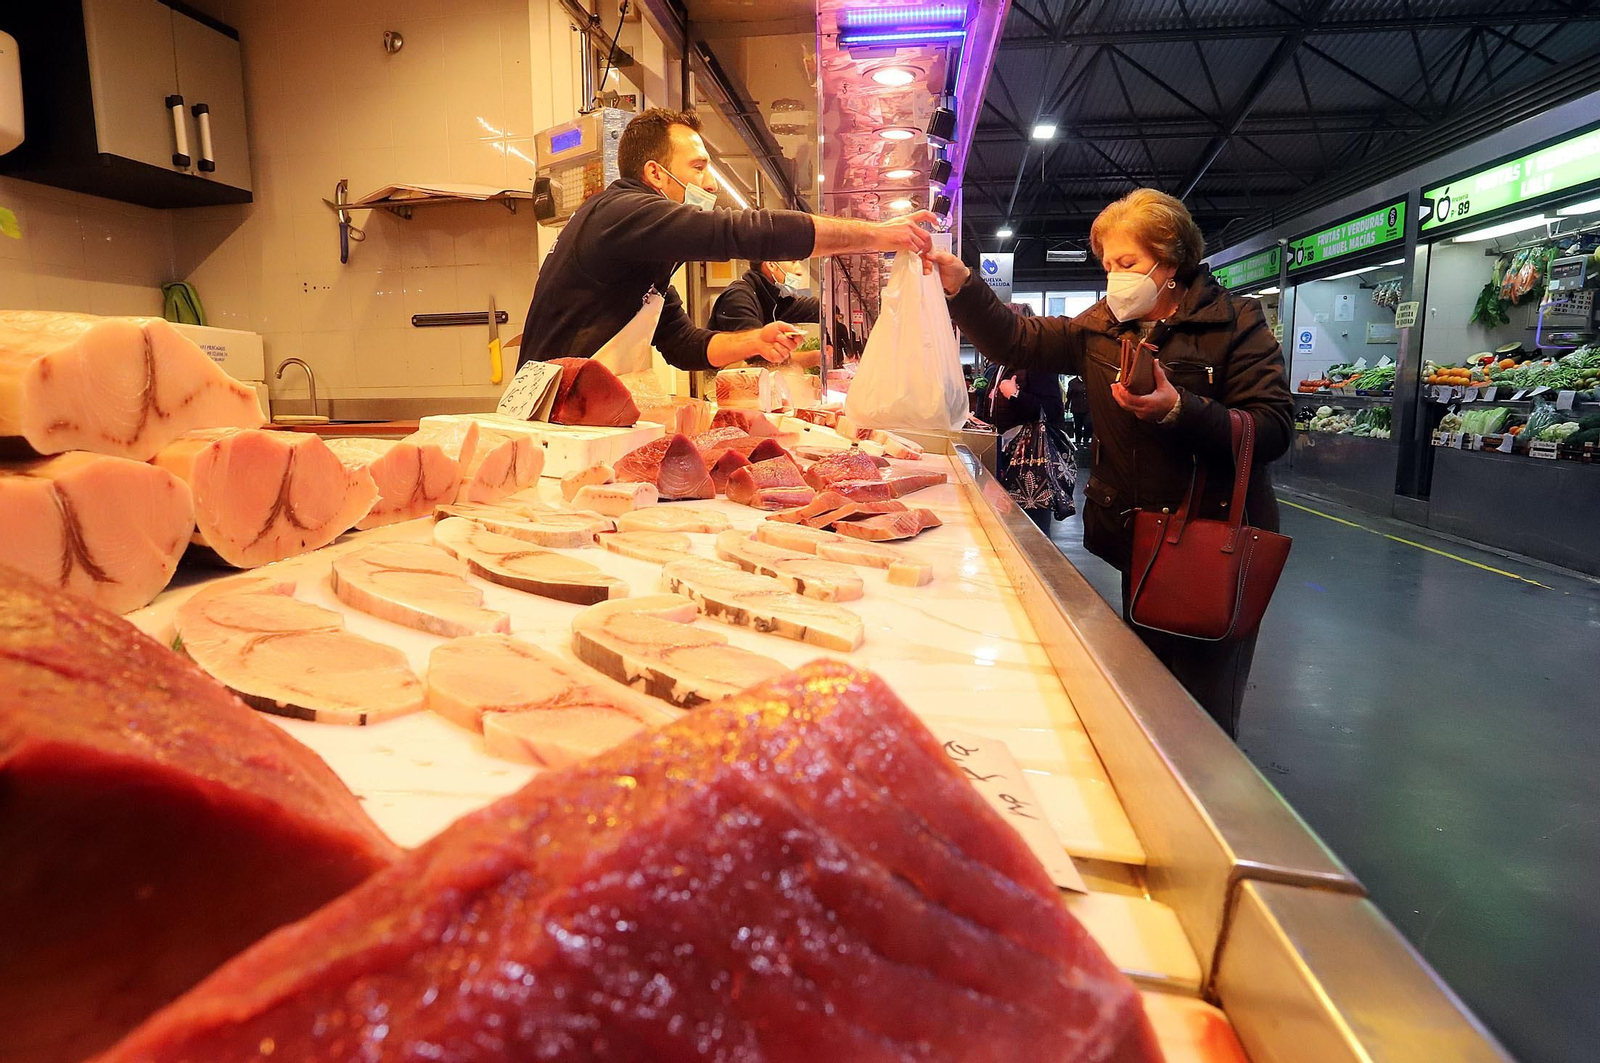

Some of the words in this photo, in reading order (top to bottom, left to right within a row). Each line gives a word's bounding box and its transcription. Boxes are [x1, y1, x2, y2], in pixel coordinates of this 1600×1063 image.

[1317, 227, 1340, 247] FRUTAS
[1341, 226, 1347, 237] Y
[1347, 213, 1385, 236] VERDURAS
[1322, 240, 1348, 258] MANUEL
